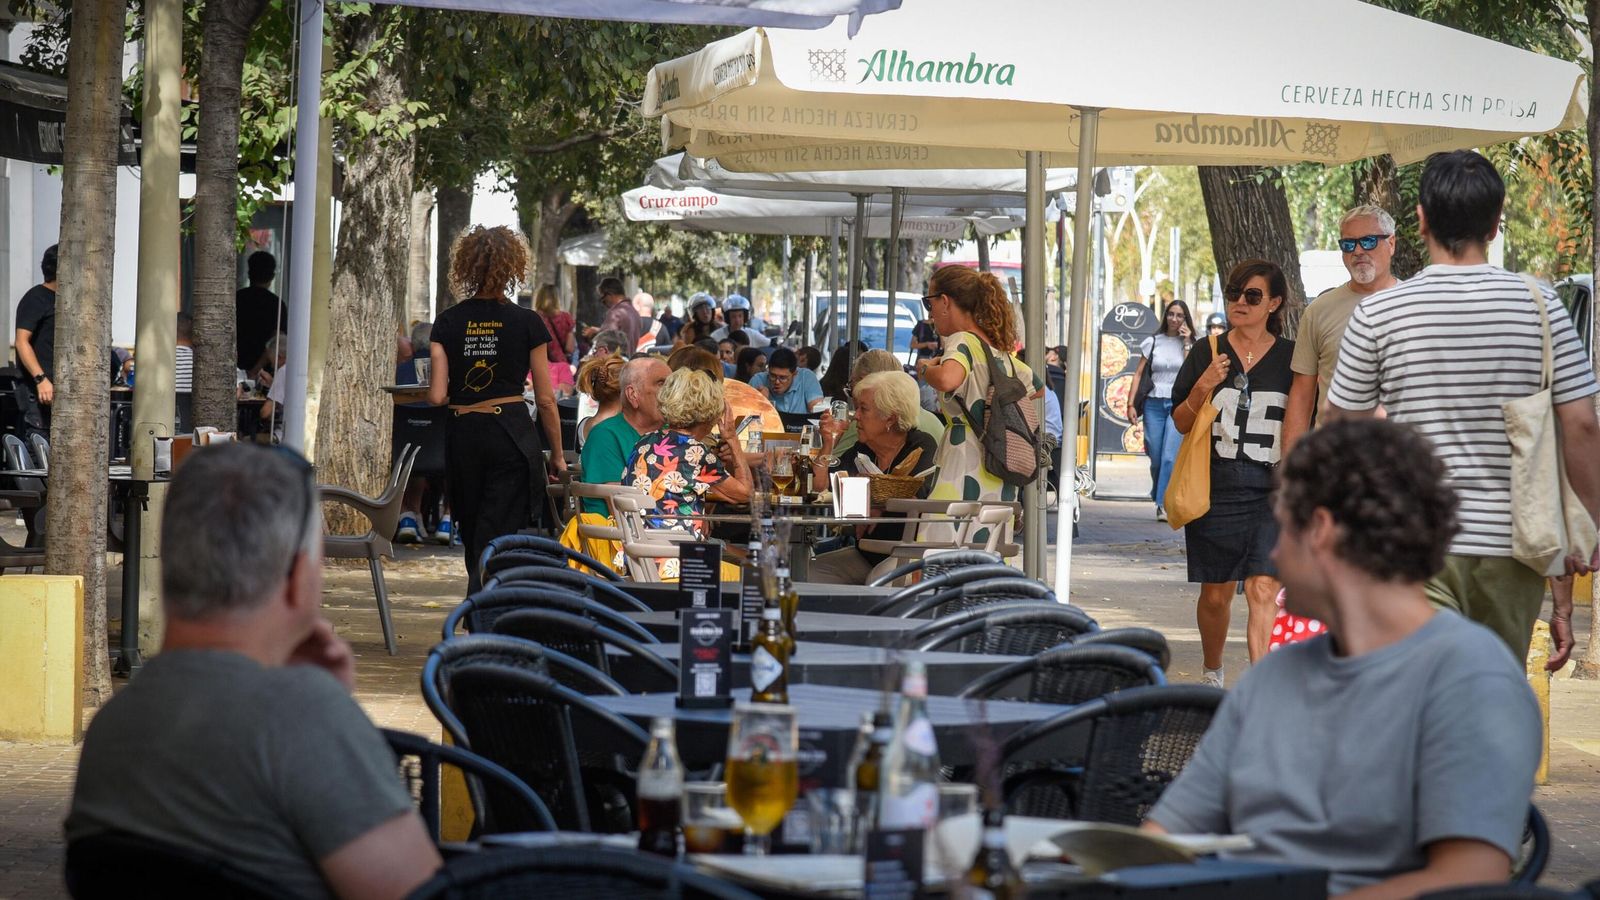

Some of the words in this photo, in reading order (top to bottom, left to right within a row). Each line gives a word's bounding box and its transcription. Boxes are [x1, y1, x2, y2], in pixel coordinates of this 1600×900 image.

[856, 49, 1016, 86] Alhambra
[1281, 84, 1363, 107] CERVEZA
[1371, 89, 1434, 110] HECHA
[1442, 93, 1473, 113] SIN
[639, 194, 719, 210] Cruzcampo
[1211, 387, 1289, 464] 45
